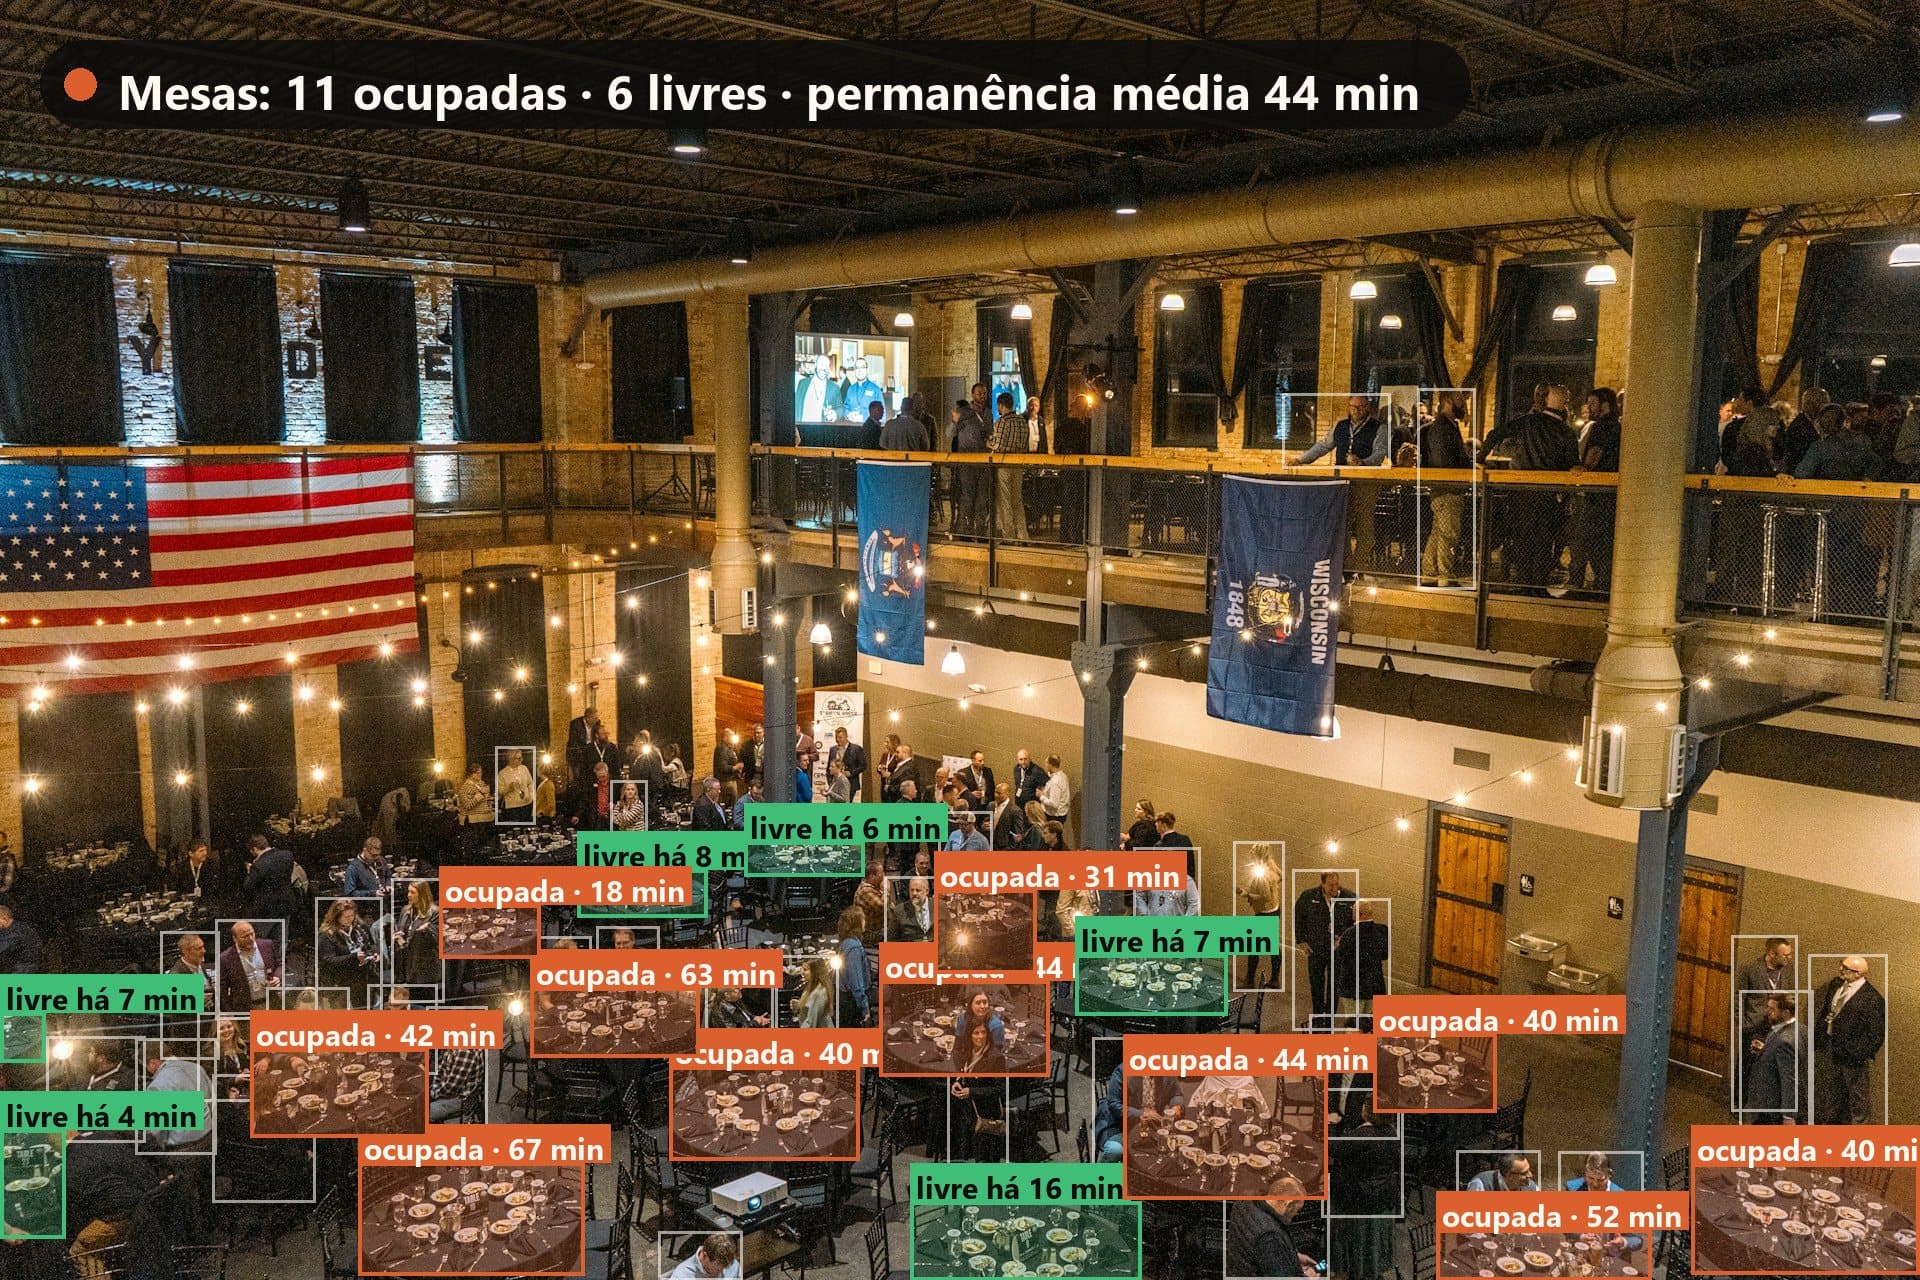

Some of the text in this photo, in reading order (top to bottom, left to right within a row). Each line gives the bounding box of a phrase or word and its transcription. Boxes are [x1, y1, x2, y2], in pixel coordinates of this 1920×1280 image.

[127, 335, 450, 381] Y D E
[1226, 580, 1245, 629] 1848
[1309, 559, 1331, 665] WISCONSIN
